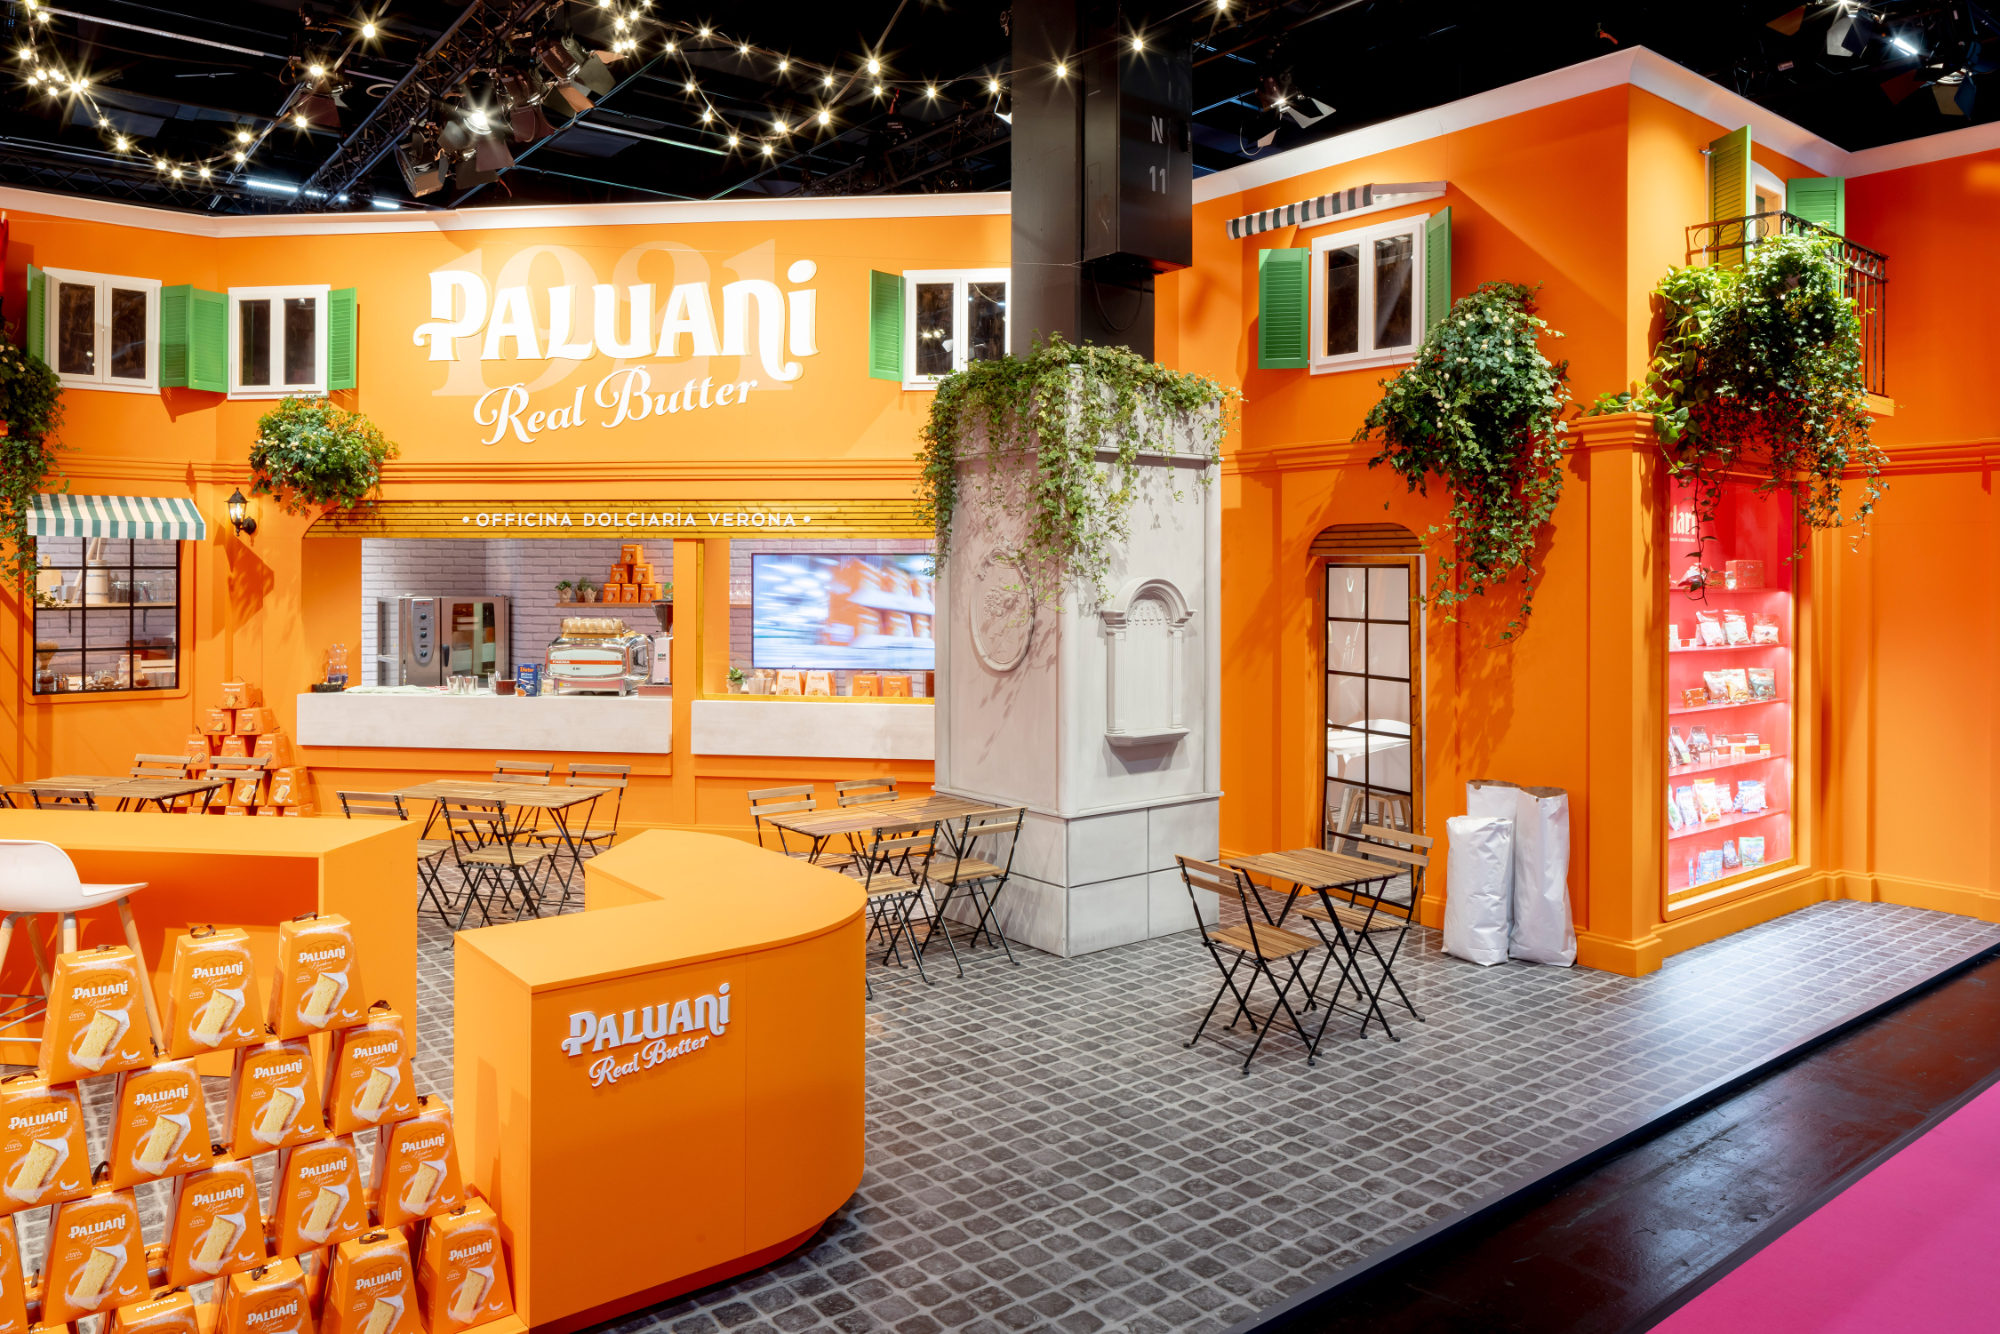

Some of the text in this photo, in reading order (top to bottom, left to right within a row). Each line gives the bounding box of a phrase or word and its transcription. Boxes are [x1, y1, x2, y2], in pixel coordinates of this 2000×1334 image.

[1151, 115, 1163, 144] N
[1149, 165, 1166, 194] 11
[473, 364, 759, 446] Real Butter
[476, 513, 797, 528] OFFICINA DOLCIARIA VERONA
[589, 1035, 709, 1087] Real Butter
